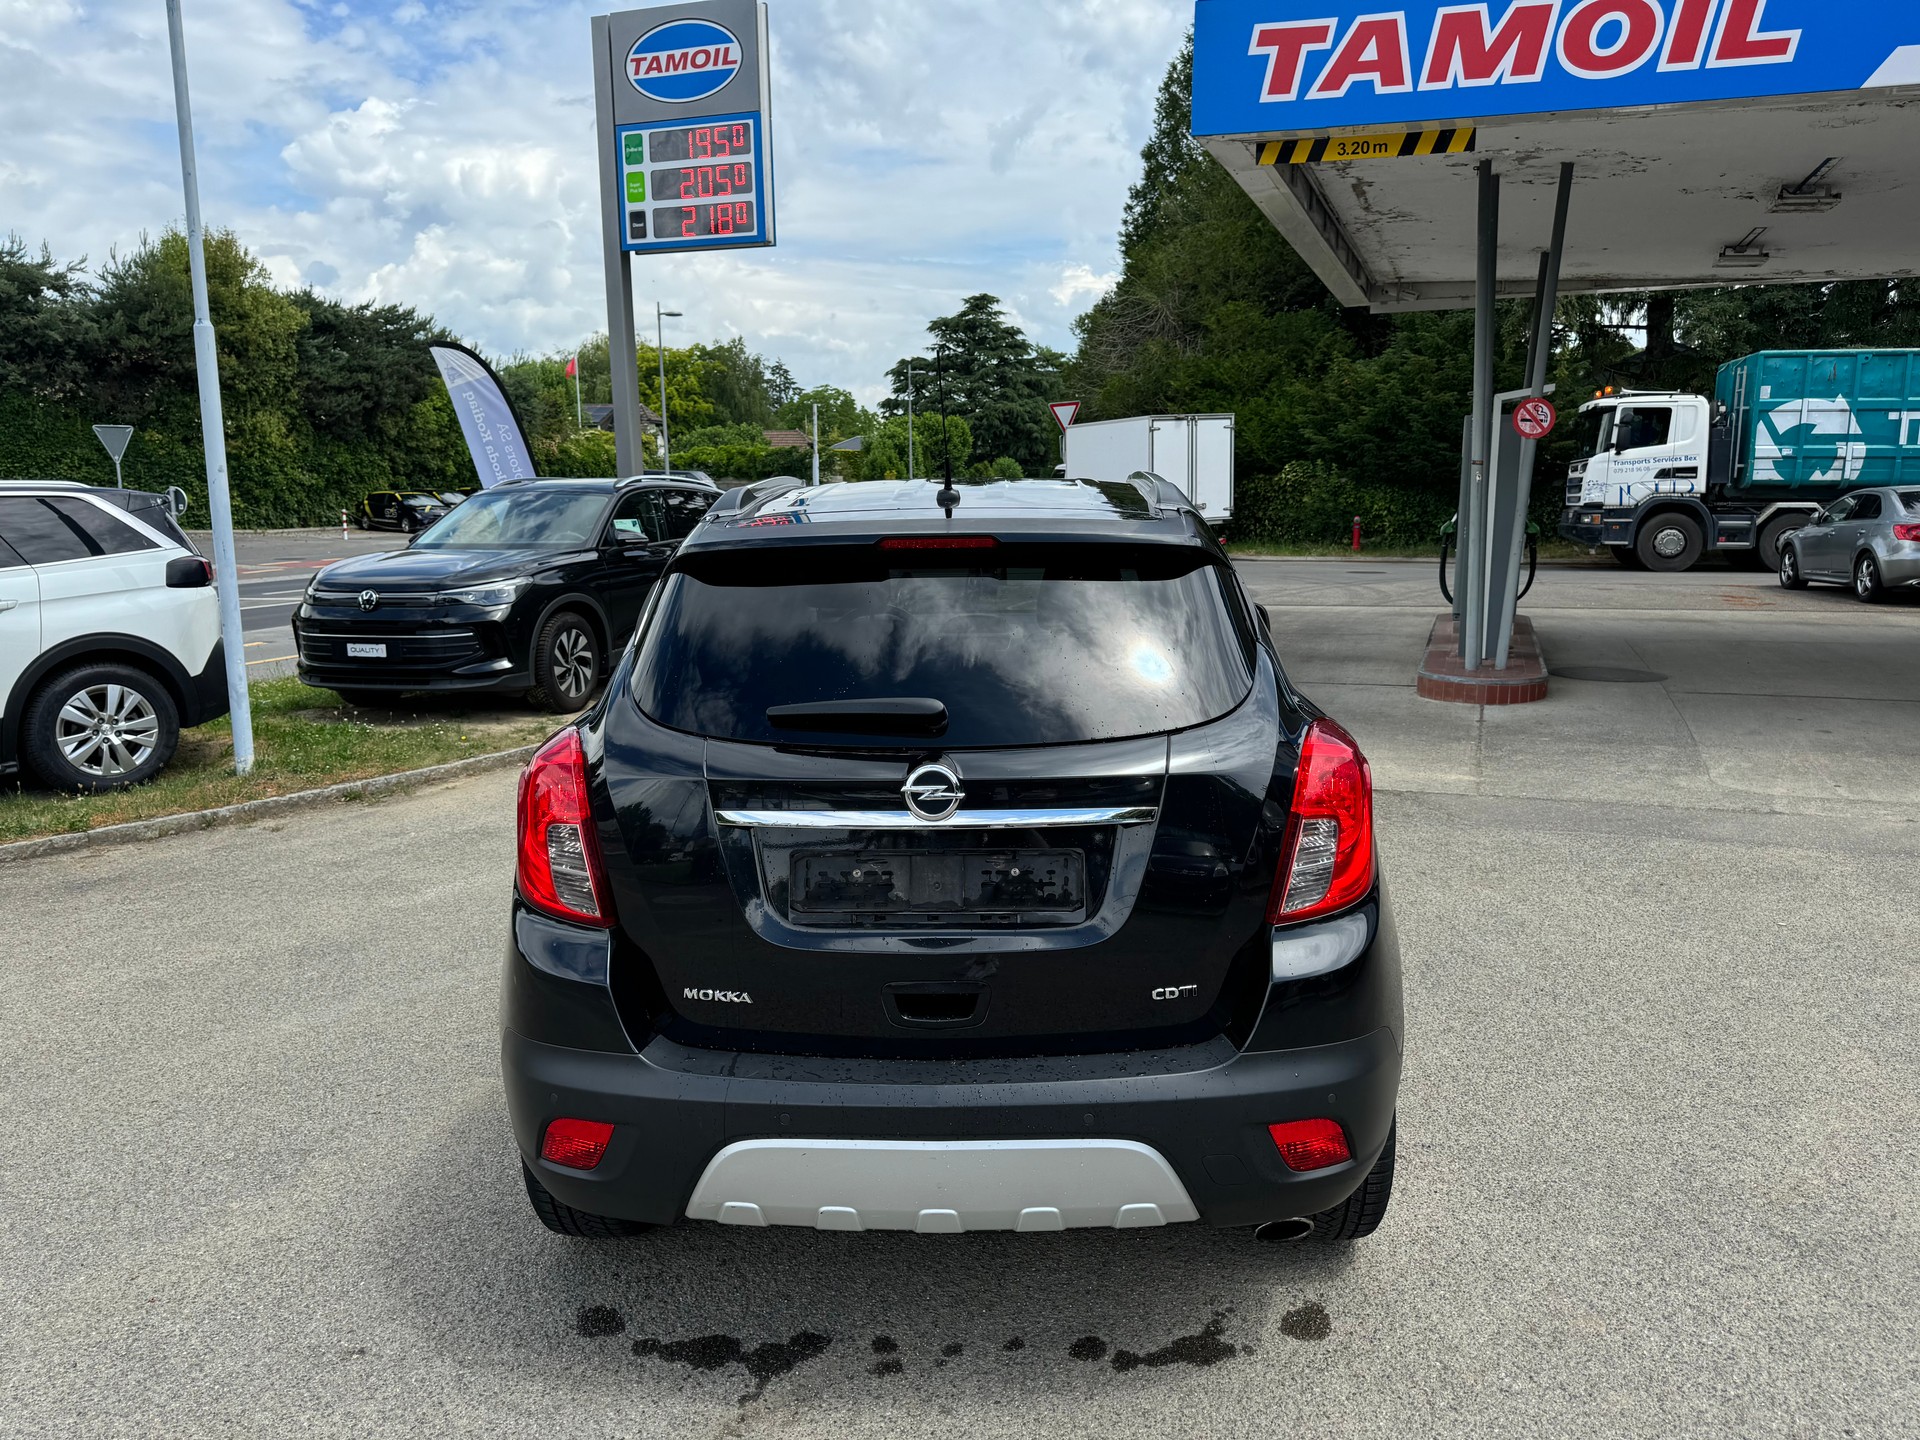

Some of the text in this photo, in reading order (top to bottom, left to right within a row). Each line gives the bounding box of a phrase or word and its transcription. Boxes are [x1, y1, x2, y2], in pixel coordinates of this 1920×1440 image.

[1247, 0, 1802, 103] TAMOIL
[630, 47, 738, 76] TAMOIL
[1337, 140, 1388, 156] 3.20 m
[1888, 411, 1920, 445] T
[1613, 458, 1651, 467] Transports
[1652, 455, 1682, 464] Services
[350, 646, 379, 654] QUALITY
[683, 987, 754, 1004] MOKKA
